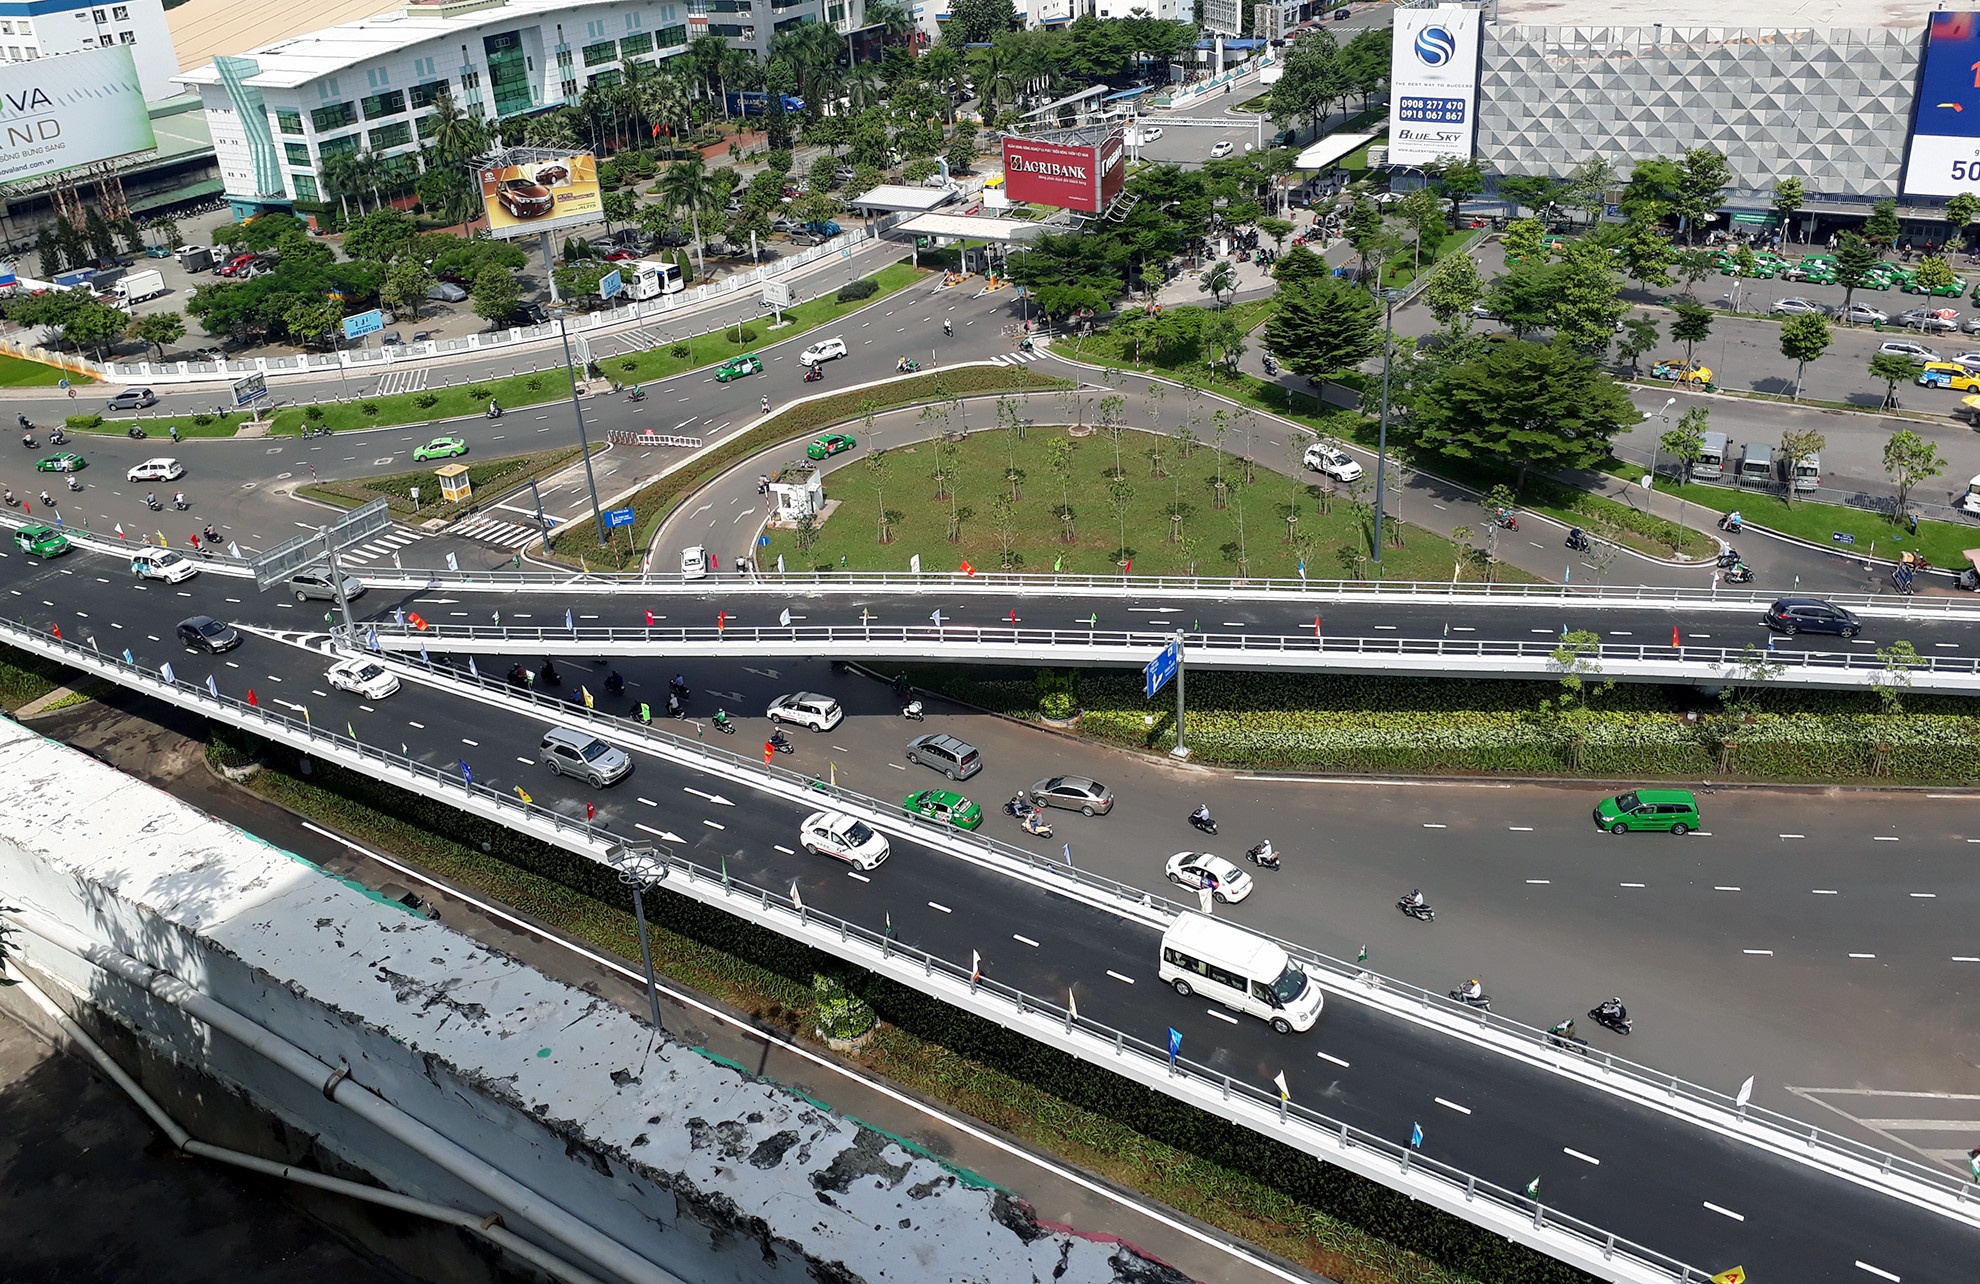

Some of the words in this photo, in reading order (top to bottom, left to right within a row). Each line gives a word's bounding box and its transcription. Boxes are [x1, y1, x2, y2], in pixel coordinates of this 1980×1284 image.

[0, 88, 52, 111] VA
[1401, 100, 1424, 109] 0908
[1426, 101, 1443, 109] 277
[1446, 102, 1464, 110] 470
[1401, 110, 1423, 119] 0918
[1426, 111, 1443, 120] 067
[1445, 112, 1463, 120] 867
[1398, 129, 1431, 140] BLUE
[1436, 131, 1464, 142] SKY
[1023, 160, 1087, 179] AGRIBANK
